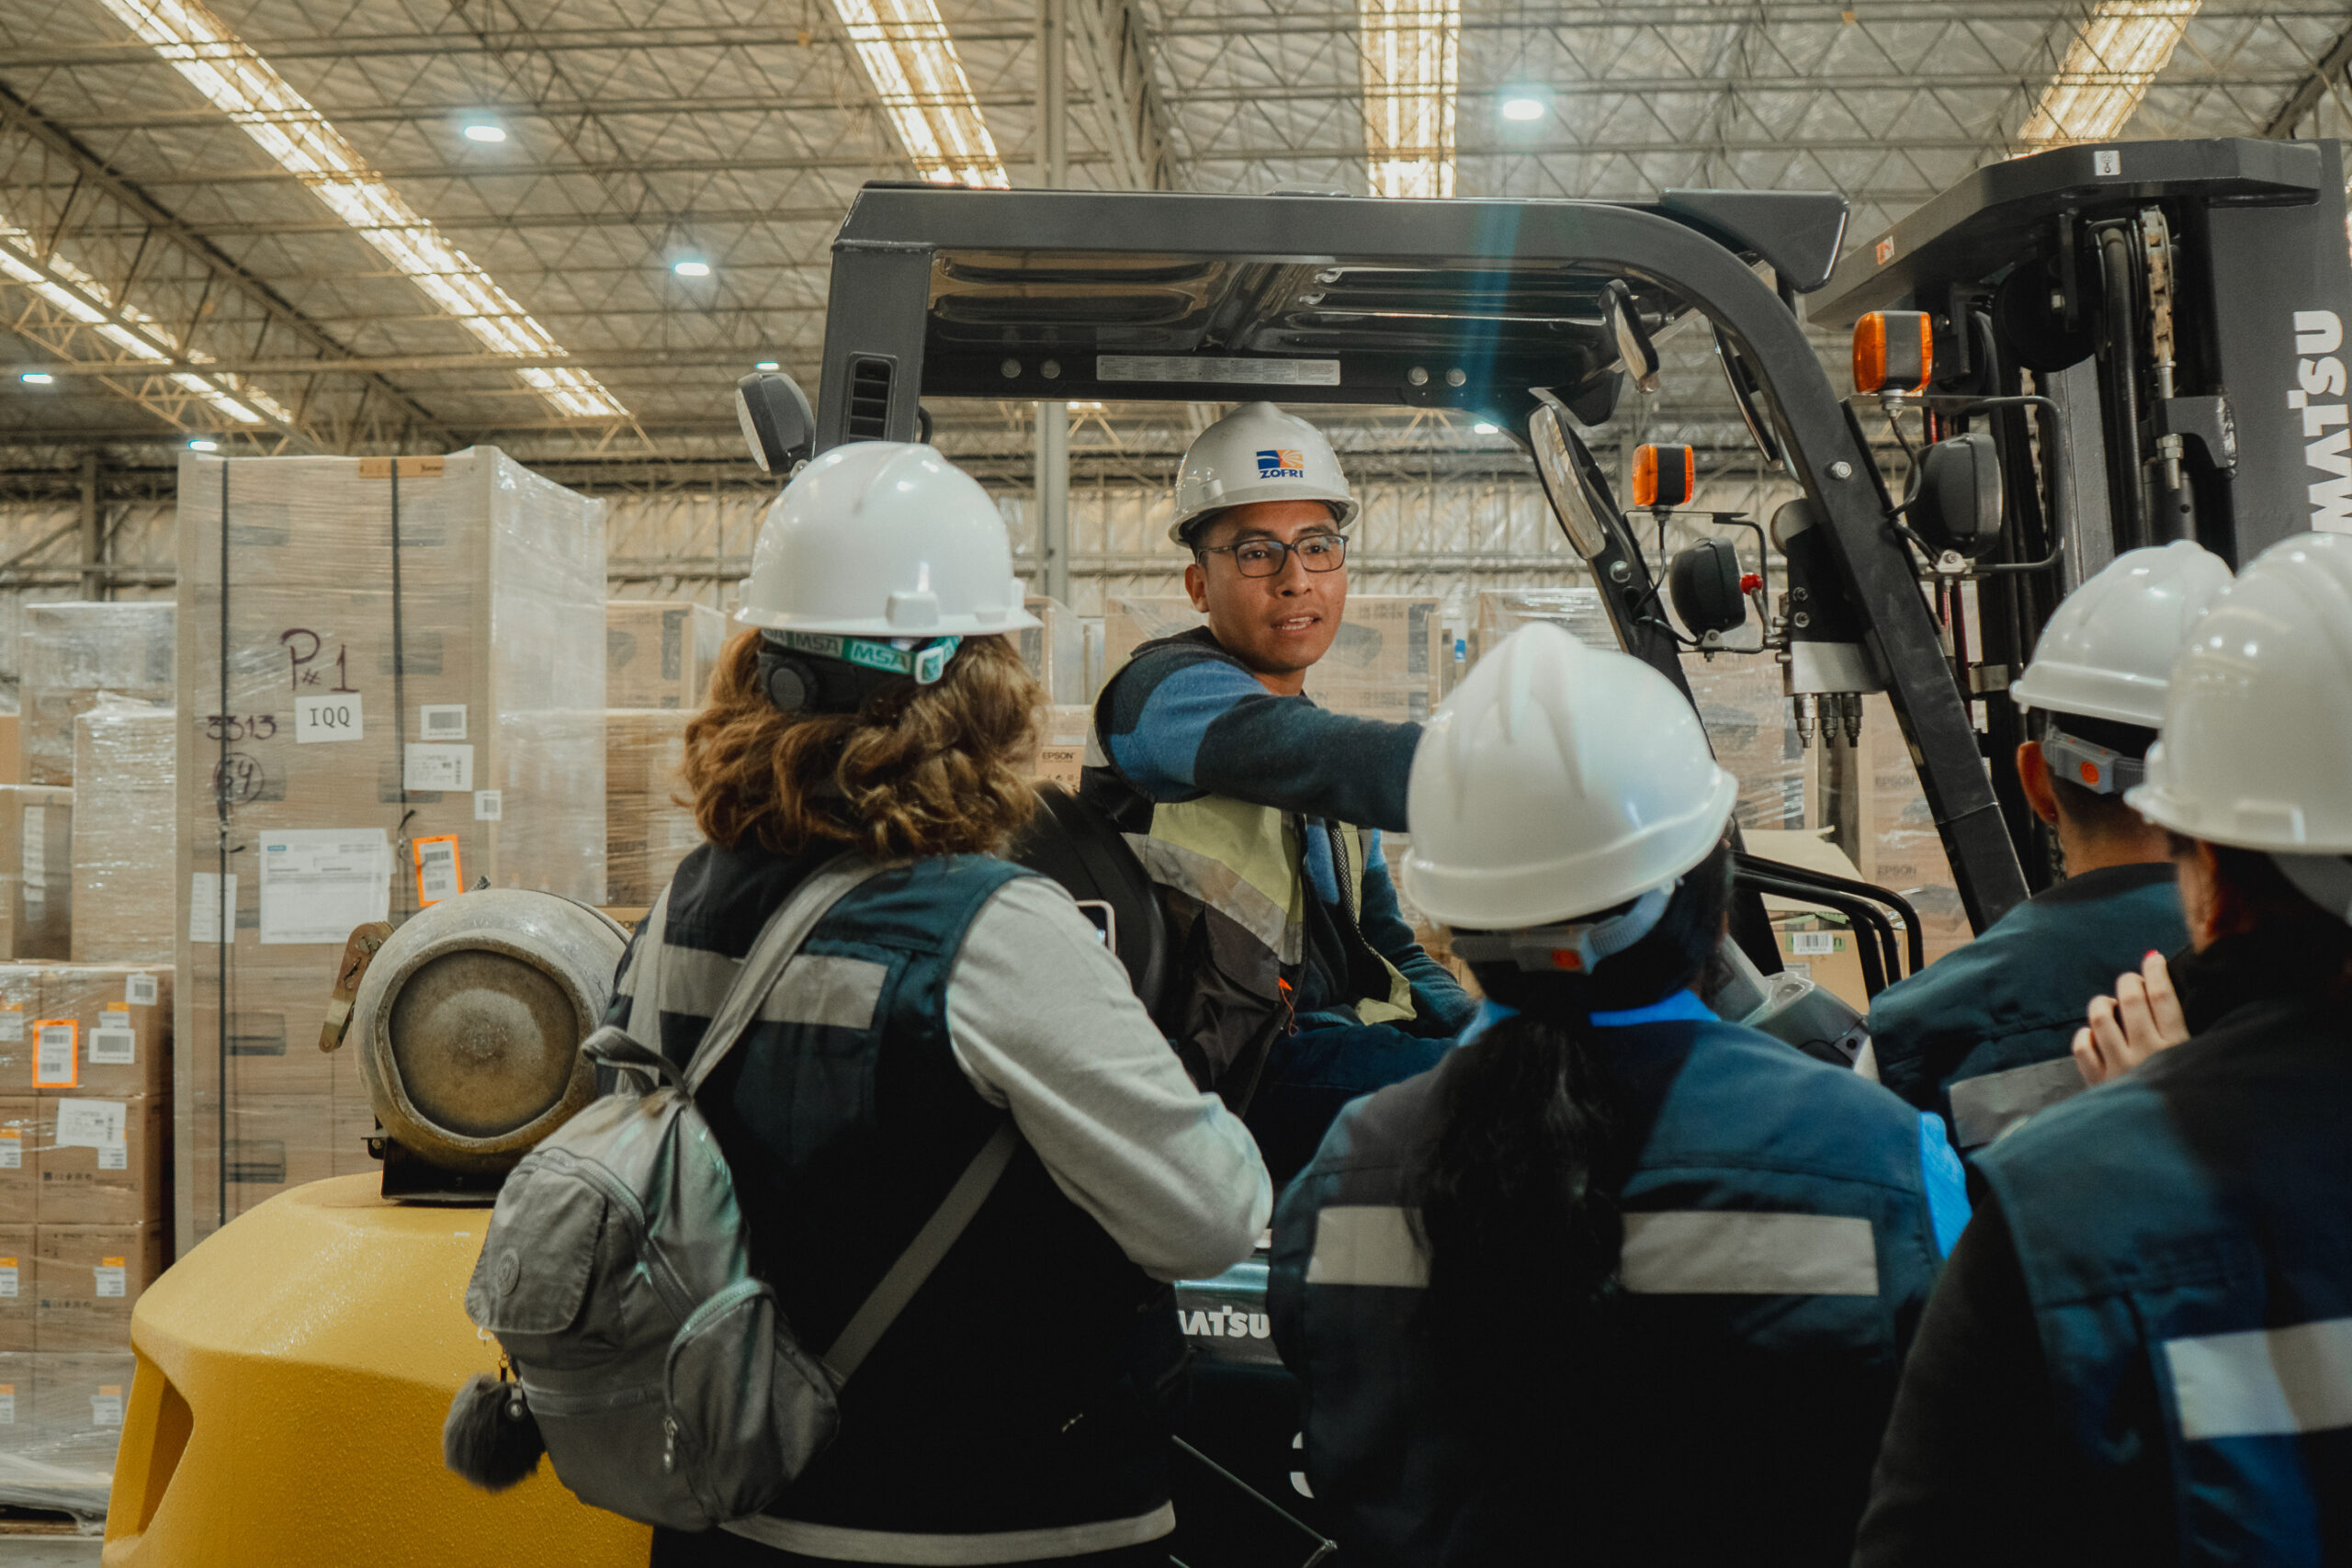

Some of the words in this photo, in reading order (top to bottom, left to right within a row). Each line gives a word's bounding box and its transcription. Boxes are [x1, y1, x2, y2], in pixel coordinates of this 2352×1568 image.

[1260, 469, 1304, 479] ZOFRI
[796, 632, 841, 655] MSA
[853, 643, 909, 671] MSA
[310, 706, 350, 728] IQQ
[1043, 751, 1073, 760] EPSON
[1877, 865, 1917, 876] EPSON
[1178, 1305, 1271, 1339] ATSU
